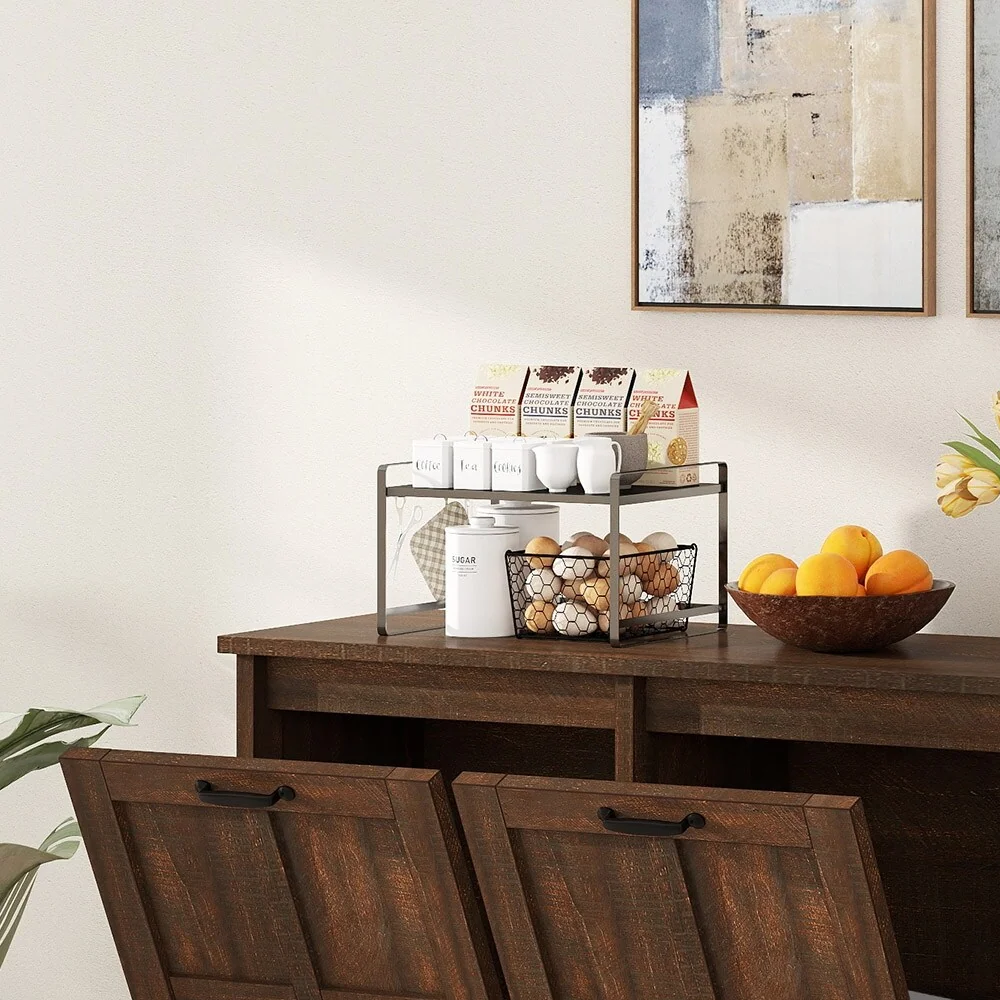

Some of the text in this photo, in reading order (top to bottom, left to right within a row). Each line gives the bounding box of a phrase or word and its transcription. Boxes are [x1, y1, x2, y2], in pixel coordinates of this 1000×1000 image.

[470, 405, 516, 413] CHUNKS
[523, 406, 568, 415] CHUNKS
[575, 408, 621, 417] CHUNKS
[629, 409, 675, 418] CHNKS
[451, 555, 476, 564] SUGAR
